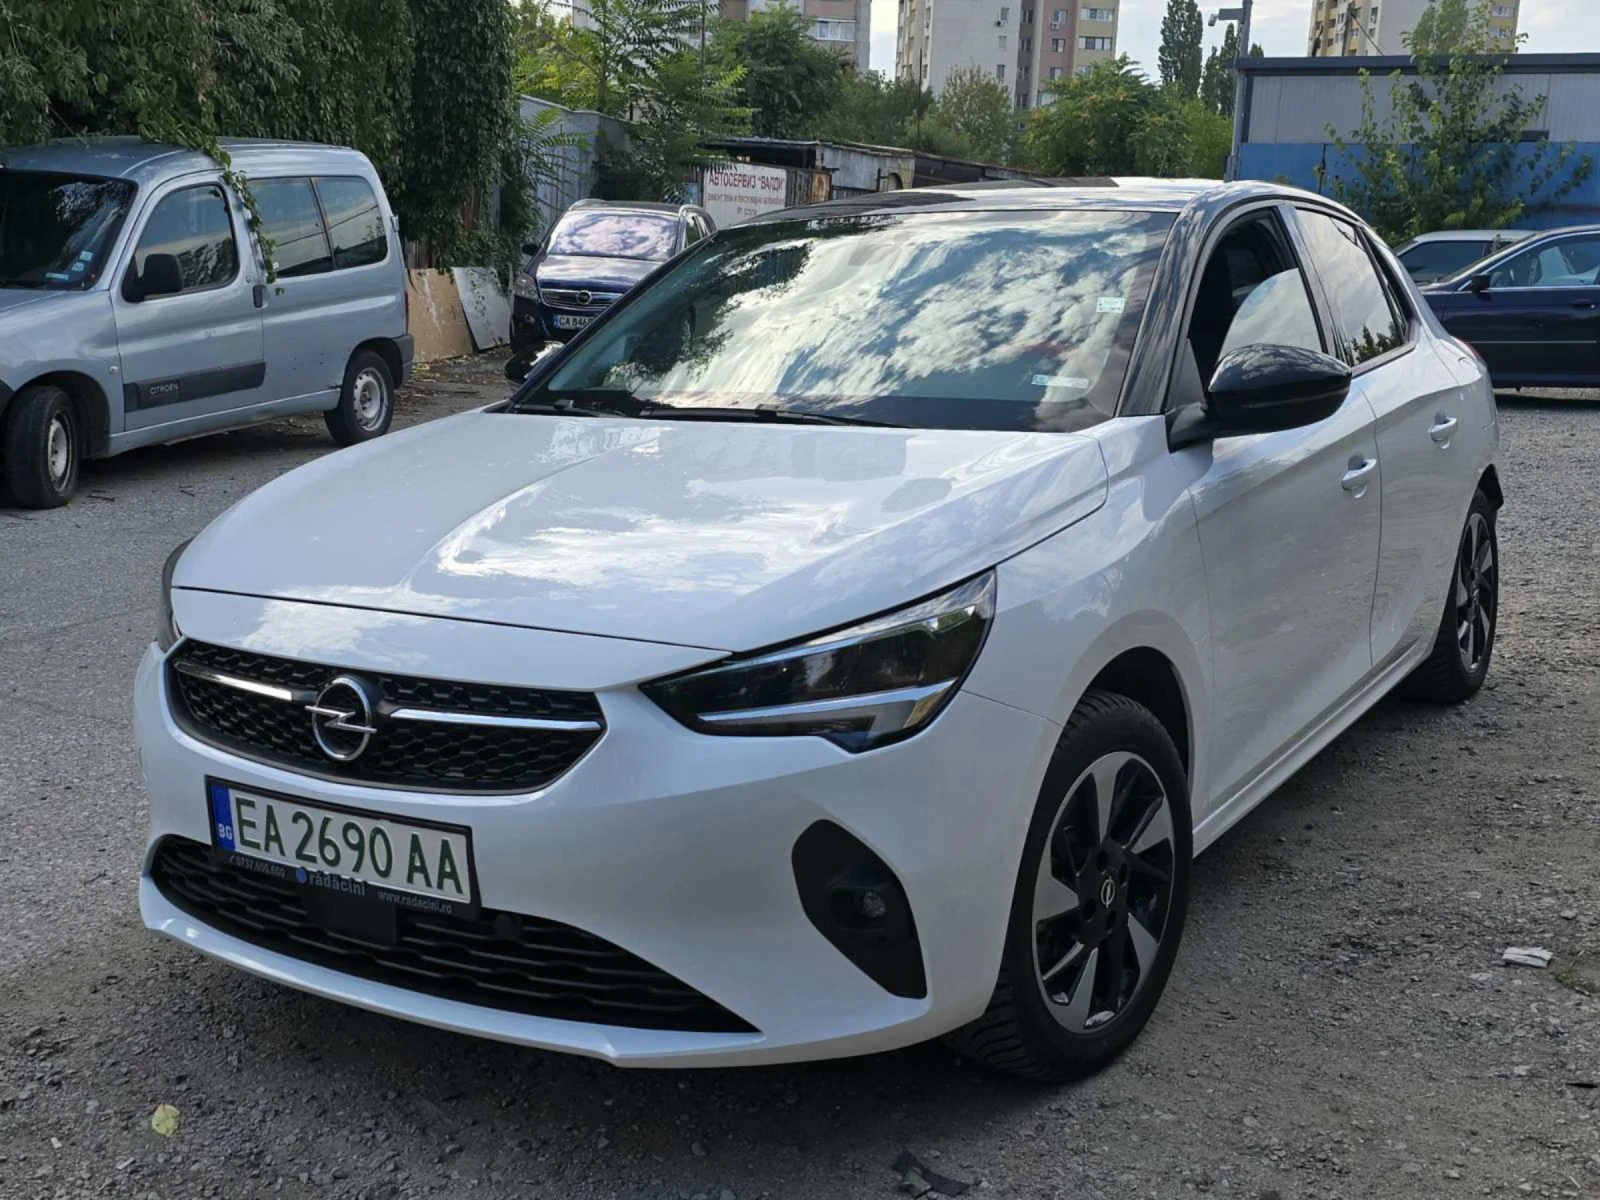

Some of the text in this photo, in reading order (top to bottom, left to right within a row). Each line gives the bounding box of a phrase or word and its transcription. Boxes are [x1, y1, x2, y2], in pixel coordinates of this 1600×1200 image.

[709, 172, 756, 188] АВТОСЕРВИЗ
[560, 316, 570, 326] CA
[218, 795, 464, 895] BG EA 2690 AA
[377, 891, 453, 914] www.radacini.ro
